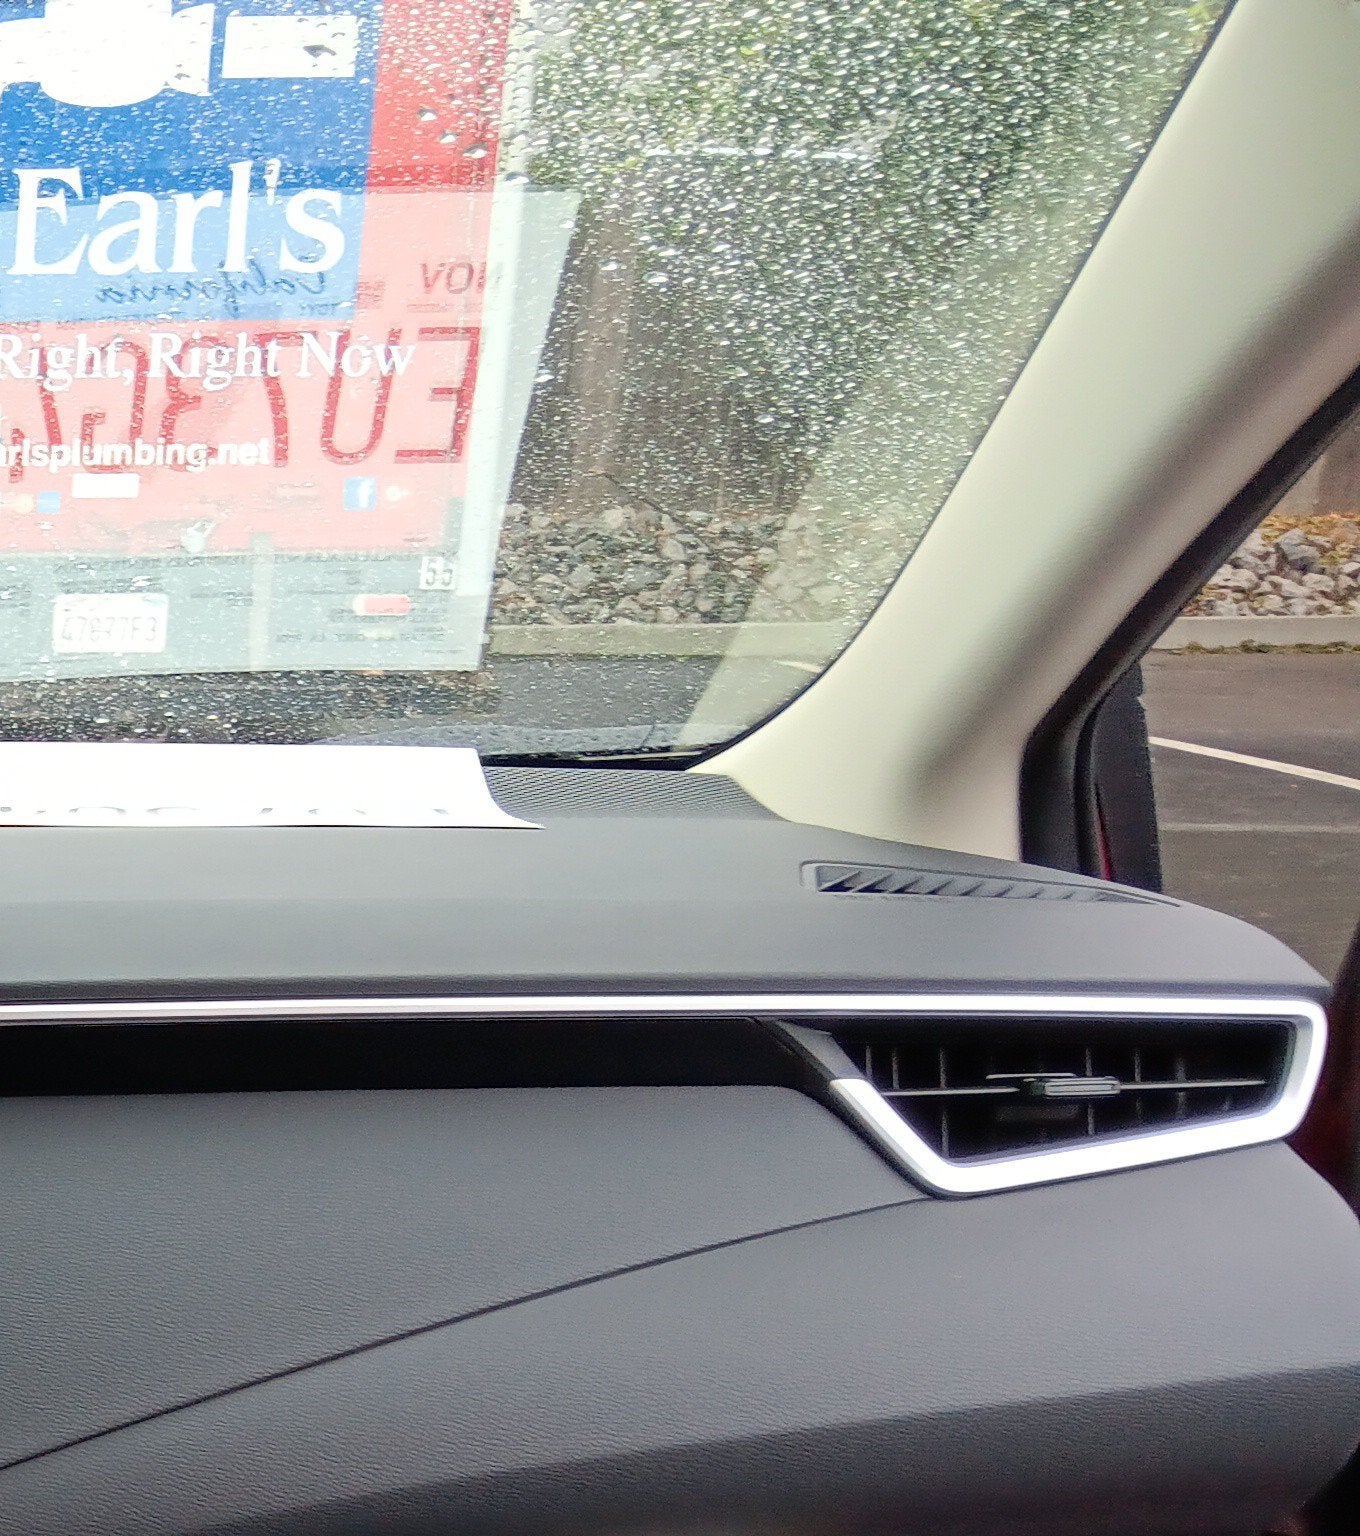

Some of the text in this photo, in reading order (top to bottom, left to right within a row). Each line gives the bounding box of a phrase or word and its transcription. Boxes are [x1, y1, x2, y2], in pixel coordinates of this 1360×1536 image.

[7, 157, 347, 278] Earl's
[149, 333, 280, 391] Right
[286, 332, 417, 379] Now
